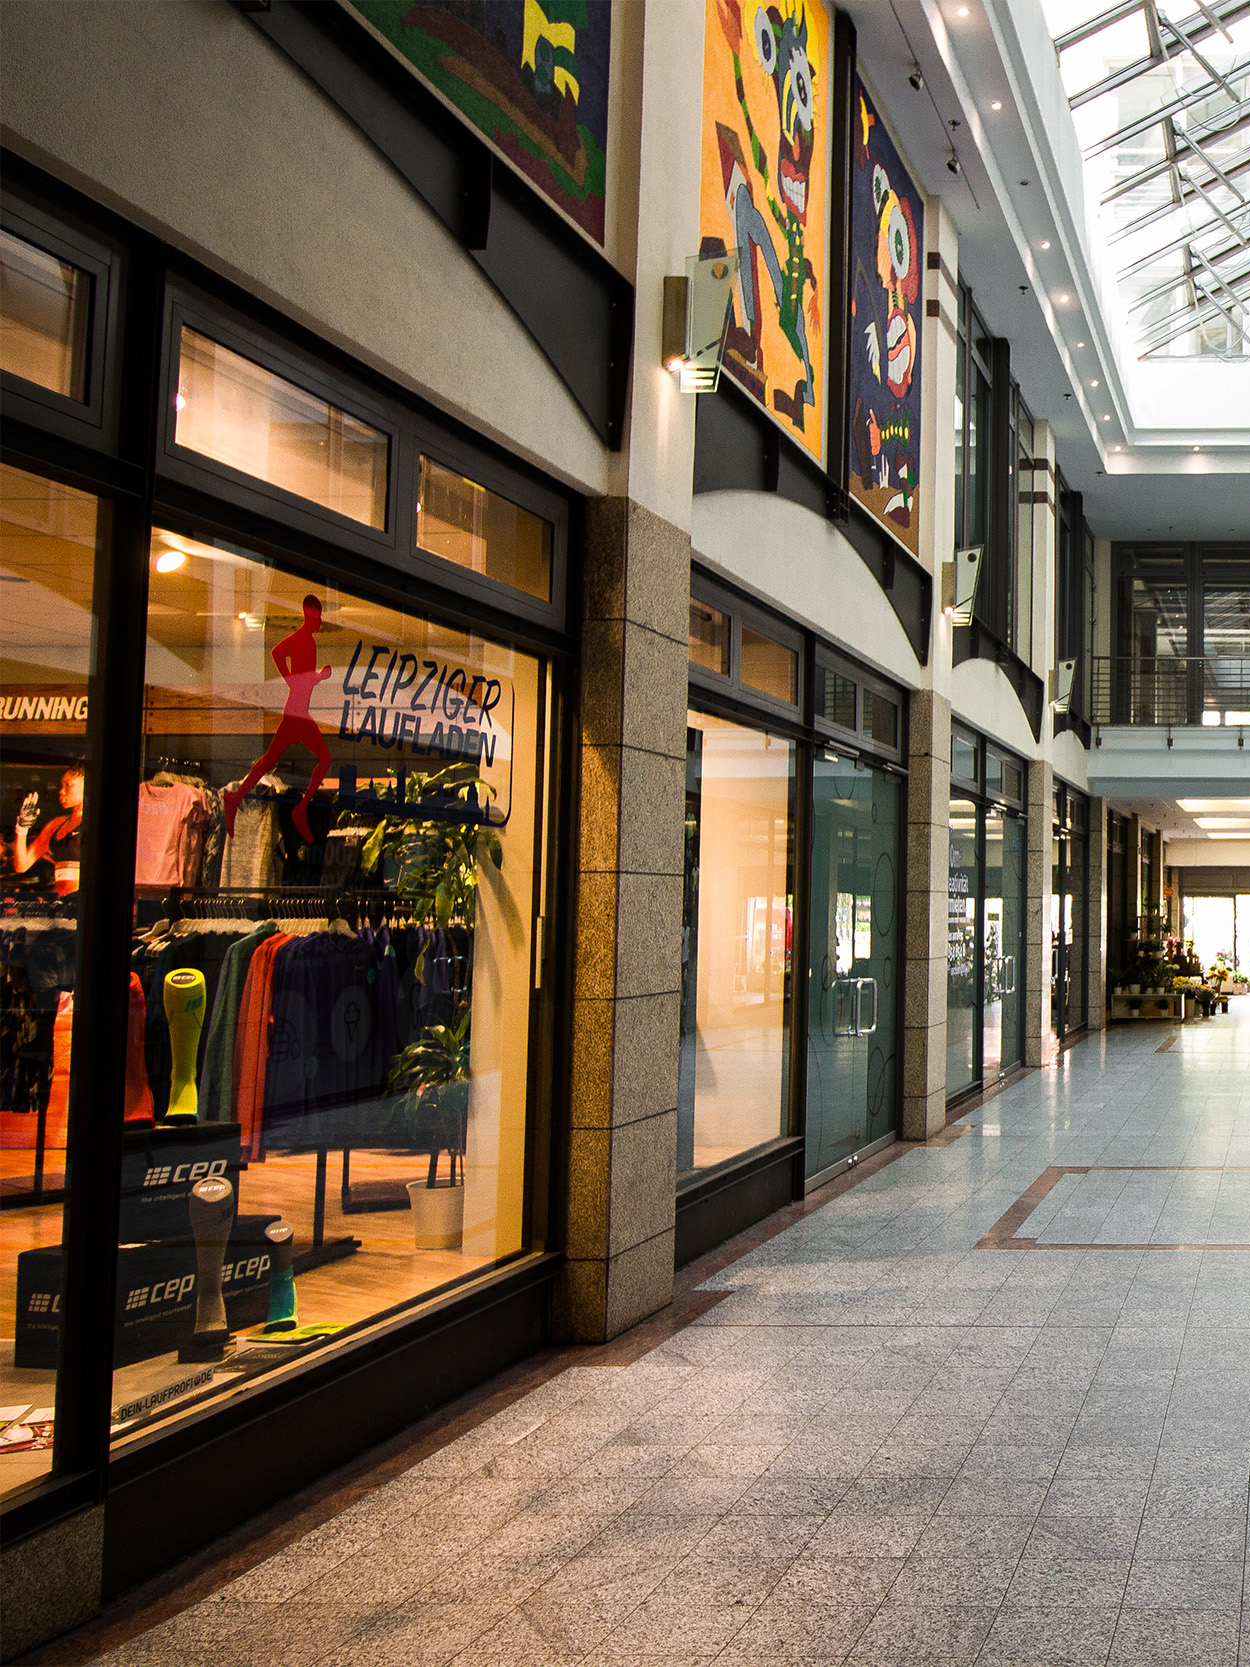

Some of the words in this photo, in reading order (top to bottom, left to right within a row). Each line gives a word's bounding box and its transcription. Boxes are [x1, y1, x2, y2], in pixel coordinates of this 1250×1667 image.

[343, 639, 501, 728] LEIPZIGER
[339, 700, 496, 767] LAUFLADEN
[948, 872, 969, 893] eativität
[172, 1159, 228, 1183] cep
[233, 1254, 270, 1280] cep
[150, 1273, 196, 1304] cep
